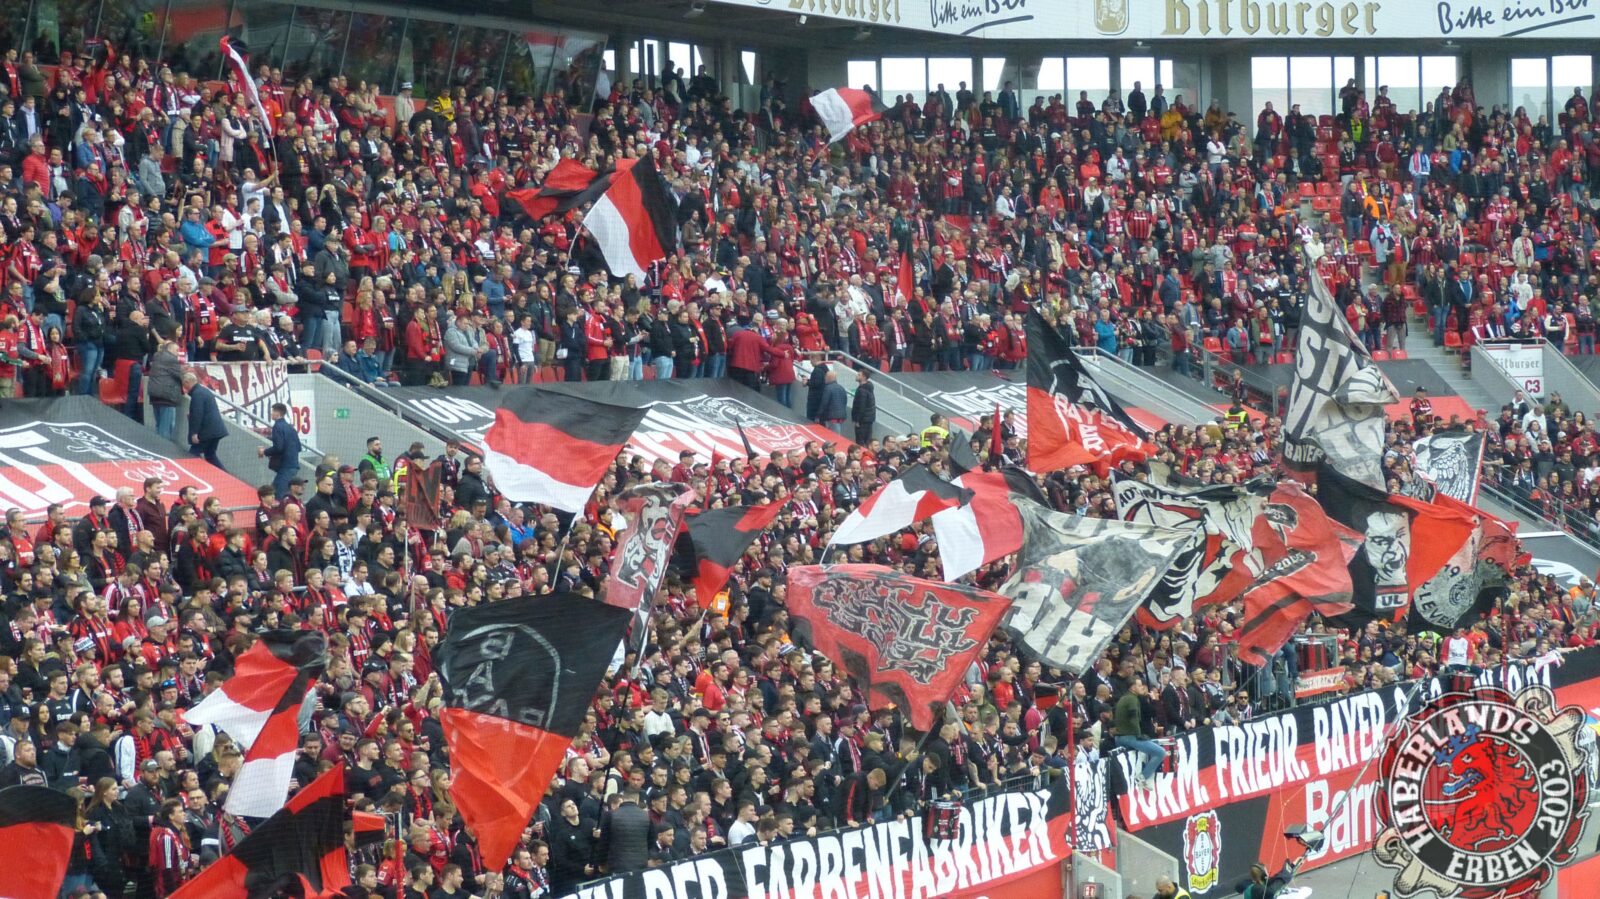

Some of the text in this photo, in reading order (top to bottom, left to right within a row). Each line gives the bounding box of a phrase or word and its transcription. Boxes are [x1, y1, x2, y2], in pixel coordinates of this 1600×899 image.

[1437, 2, 1495, 34] Bitte
[1502, 1, 1545, 21] ein
[1525, 379, 1541, 393] C3
[1381, 594, 1403, 606] UL
[1213, 713, 1310, 800] FRIEDR.
[1313, 691, 1386, 775] BAYER
